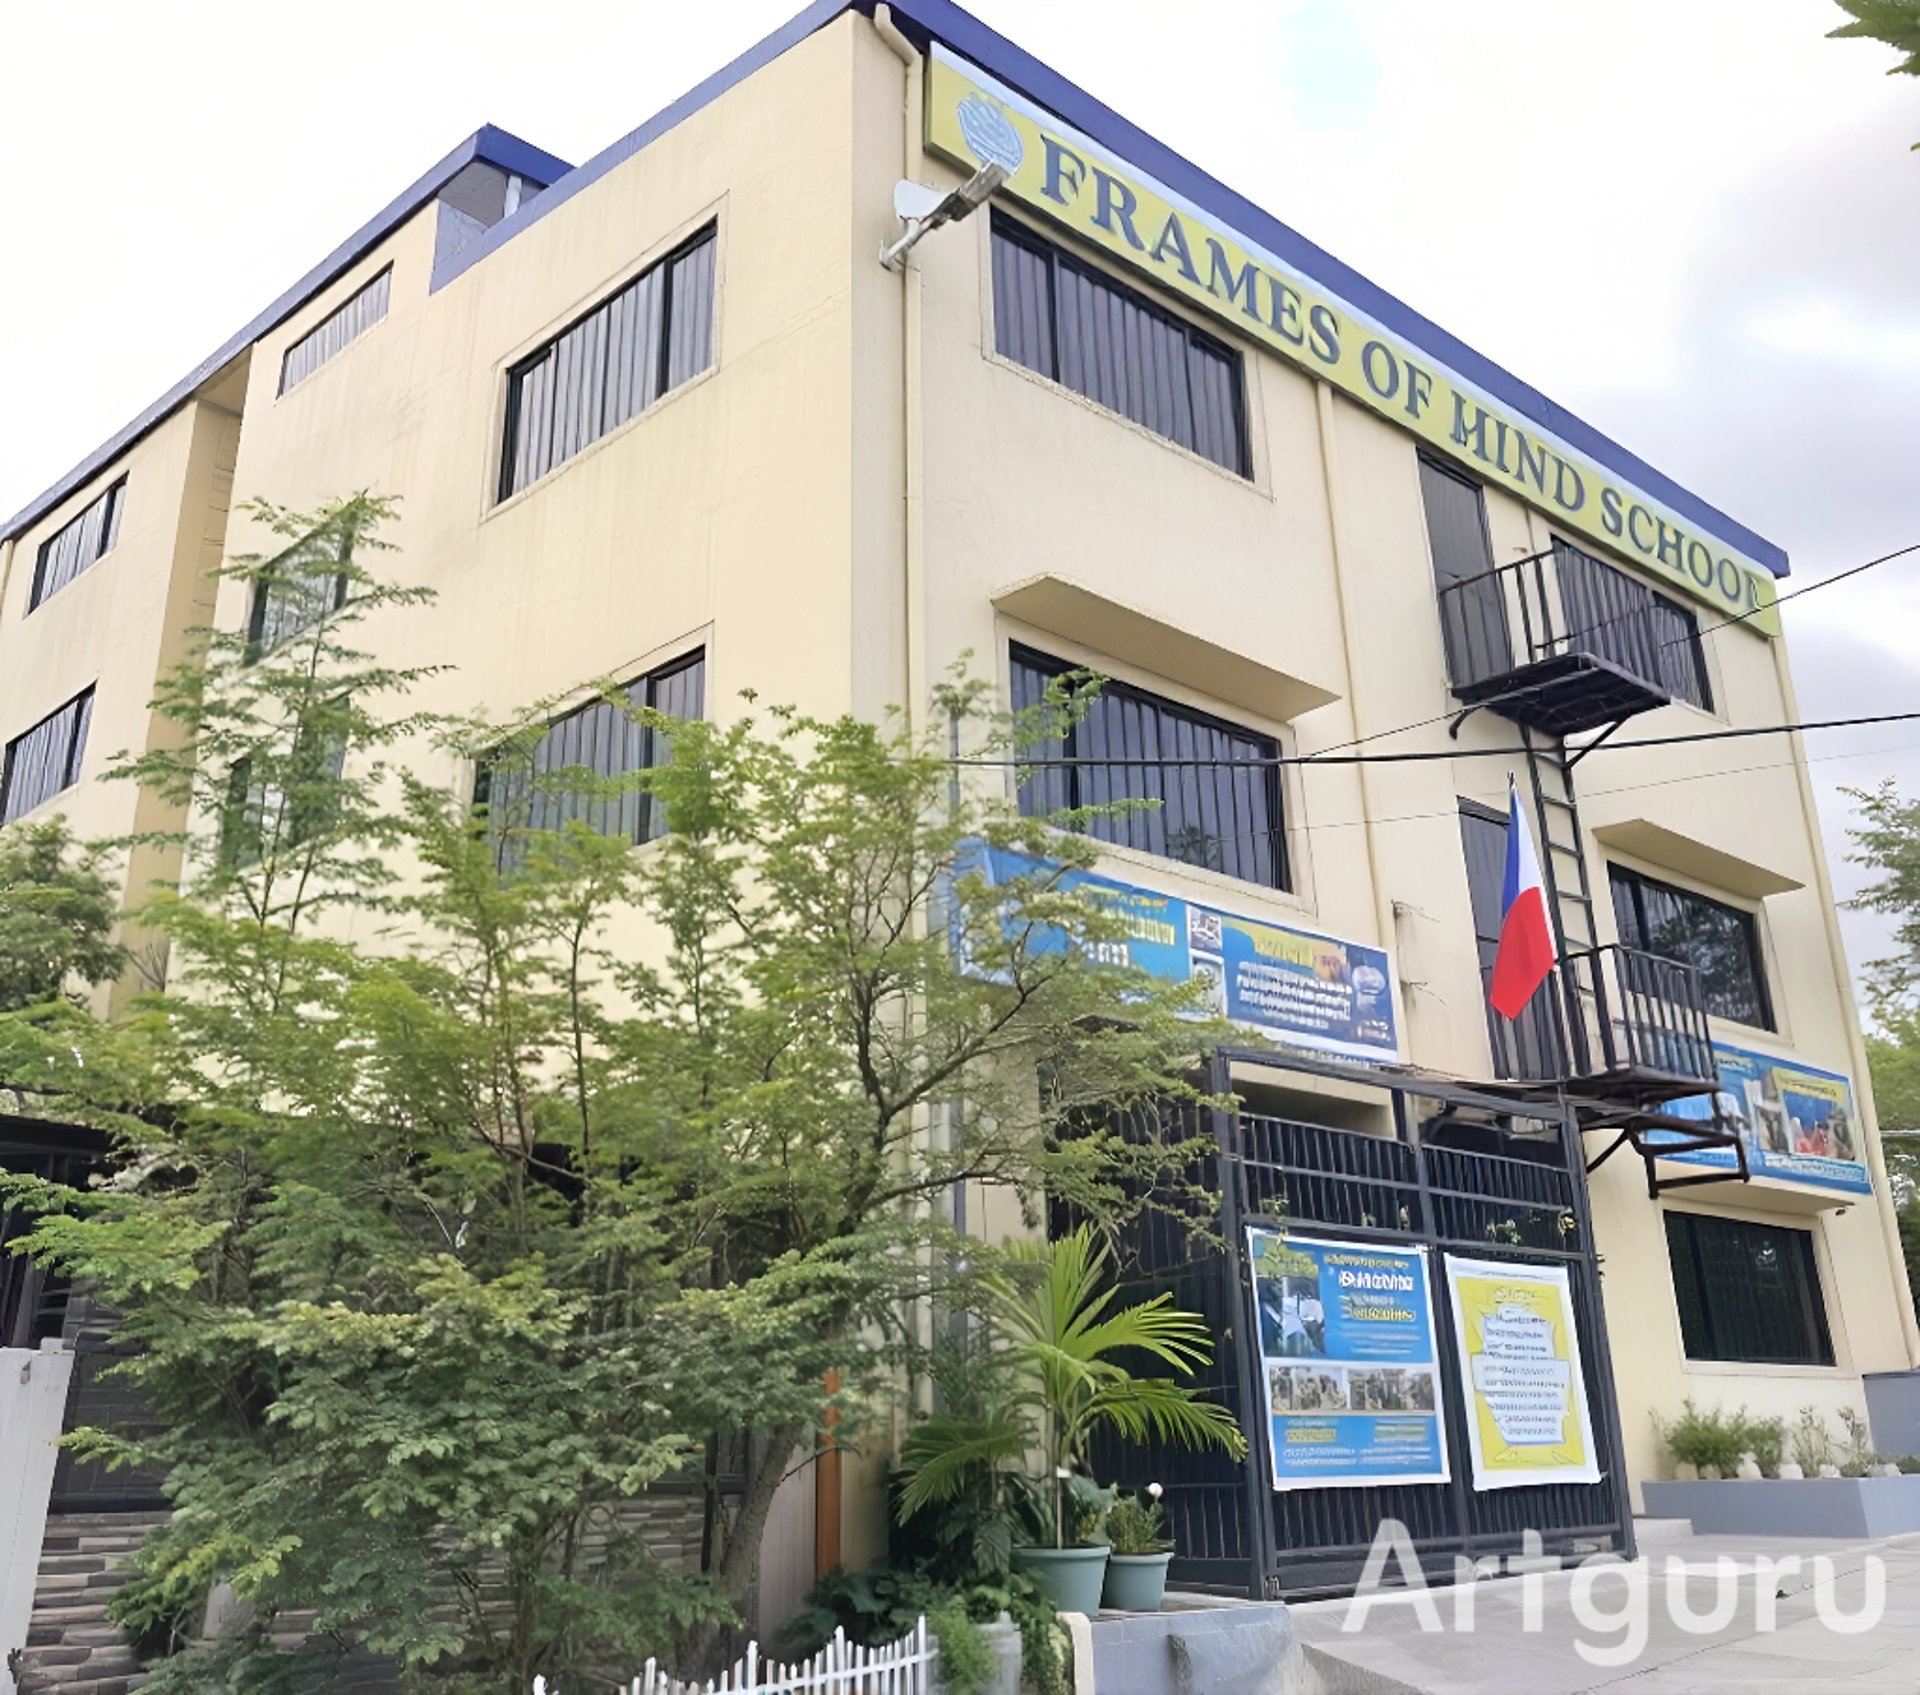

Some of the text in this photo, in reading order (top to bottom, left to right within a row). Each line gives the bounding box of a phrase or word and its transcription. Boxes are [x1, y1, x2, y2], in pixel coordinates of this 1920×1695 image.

[1040, 132, 1340, 365] FRAMES
[1361, 340, 1432, 419] OF
[1449, 389, 1585, 512] MIND
